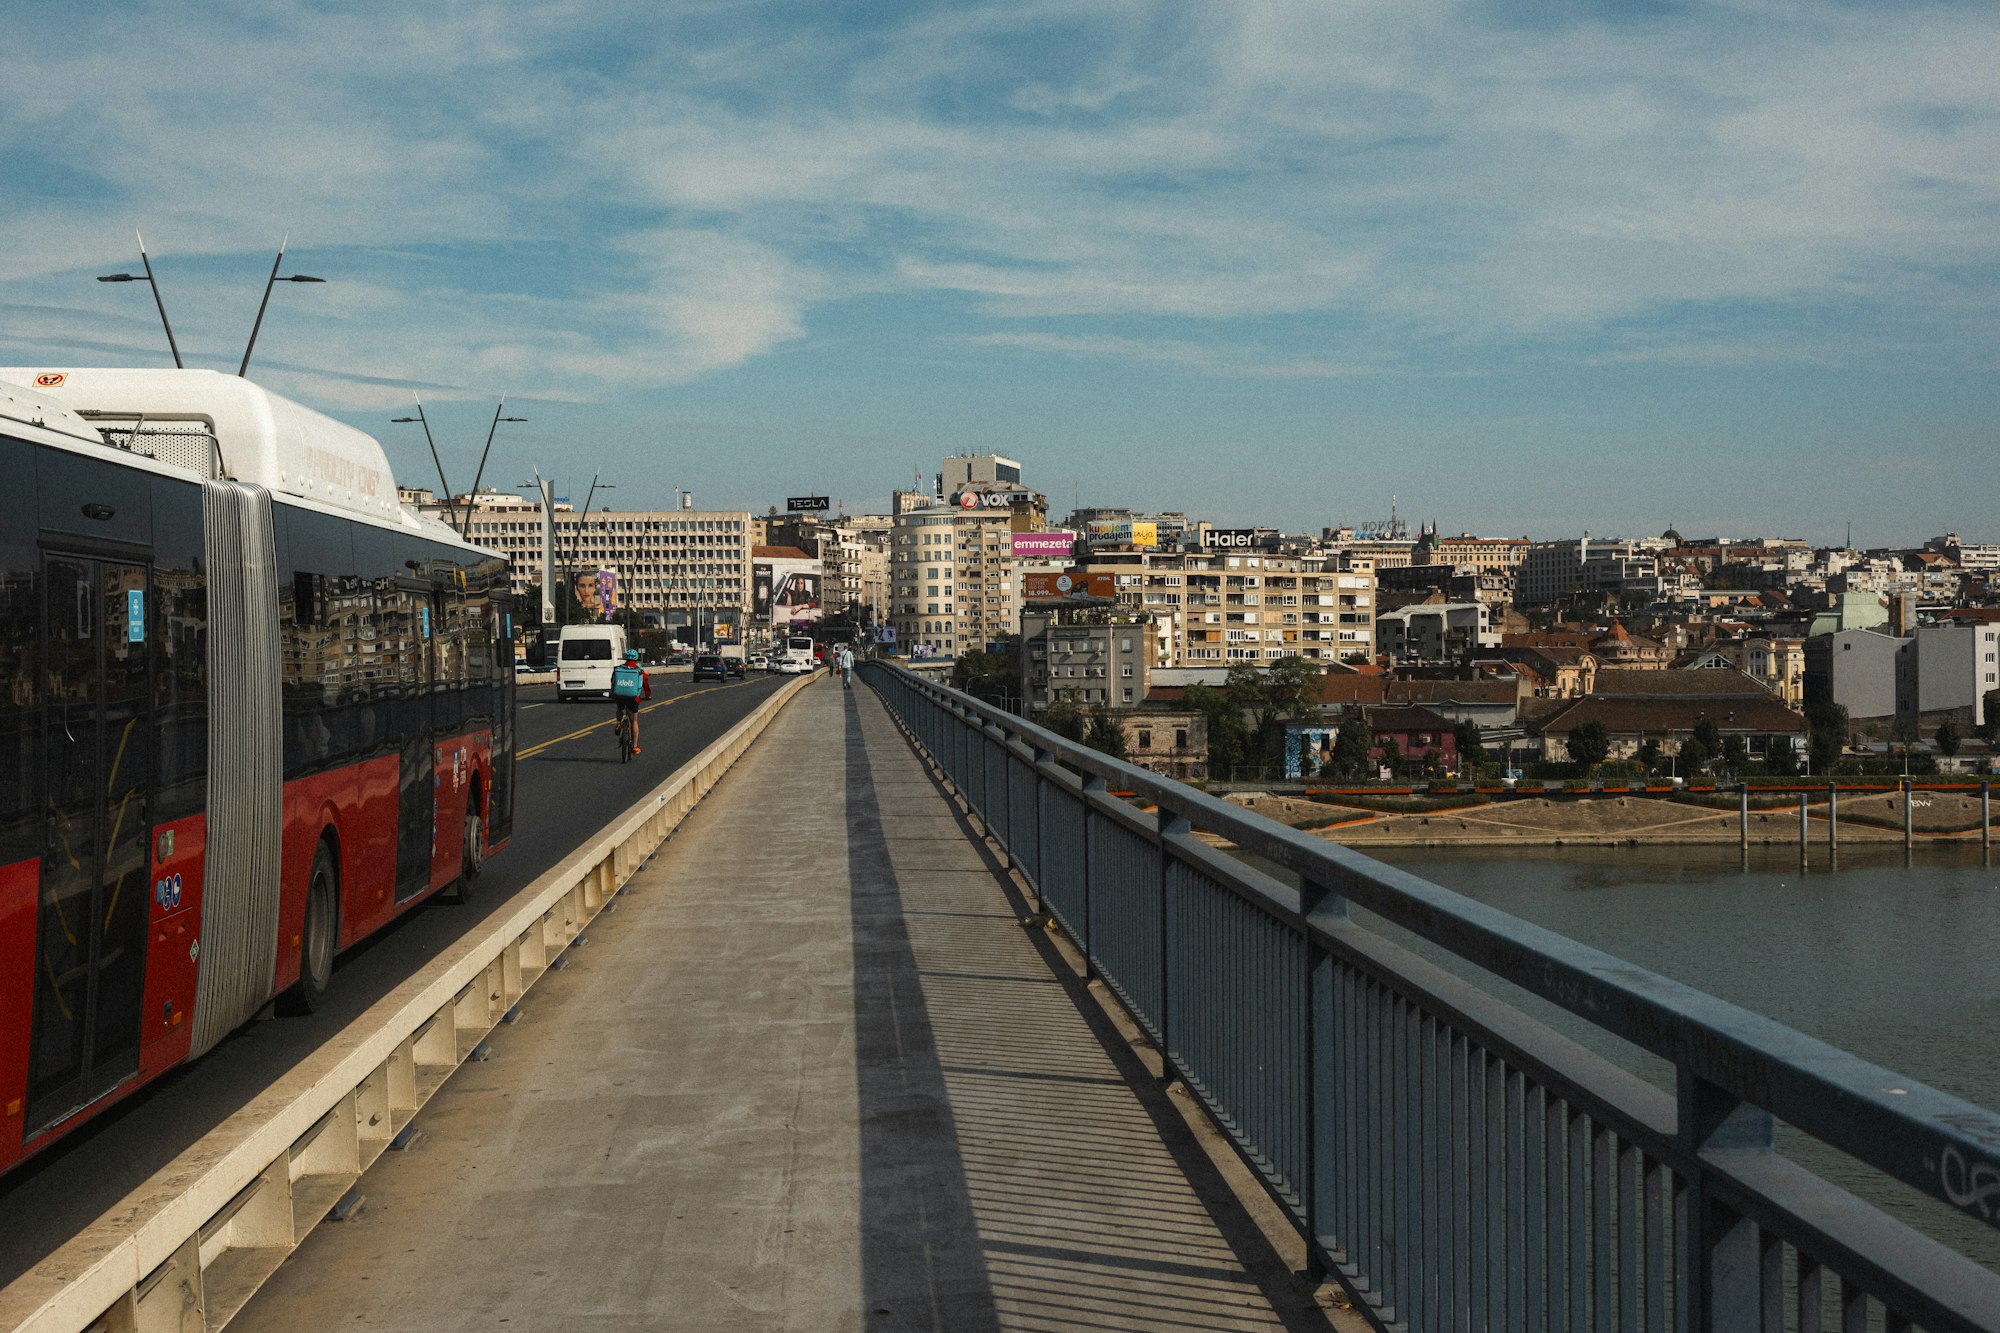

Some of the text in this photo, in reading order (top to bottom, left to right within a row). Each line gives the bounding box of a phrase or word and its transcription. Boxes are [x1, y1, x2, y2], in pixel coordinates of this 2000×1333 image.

[789, 499, 827, 508] TESLA
[980, 493, 1010, 507] VOX
[1090, 523, 1130, 536] kupujem
[1089, 531, 1132, 542] prodajem
[1205, 530, 1253, 547] Haier
[1014, 539, 1073, 549] emmezeta
[617, 679, 634, 687] Wolt
